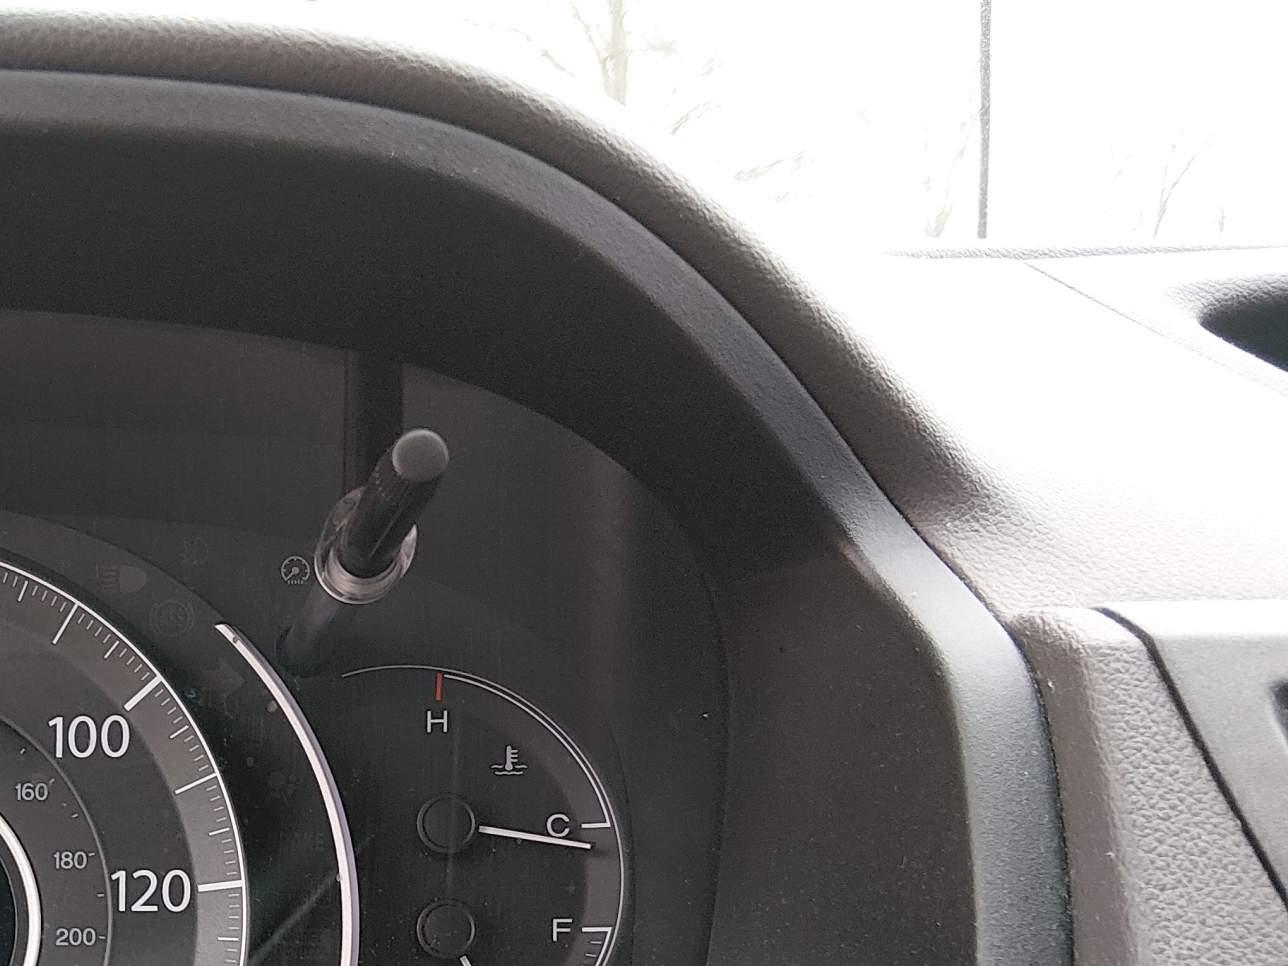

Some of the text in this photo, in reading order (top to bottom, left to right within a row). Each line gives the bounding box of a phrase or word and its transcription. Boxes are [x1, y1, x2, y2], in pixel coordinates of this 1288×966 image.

[427, 711, 448, 732] H
[48, 715, 131, 759] 100
[15, 782, 49, 801] 160
[546, 813, 571, 837] C
[53, 851, 88, 870] 180
[111, 869, 192, 913] 120
[55, 928, 96, 947] 200
[552, 919, 572, 942] F
